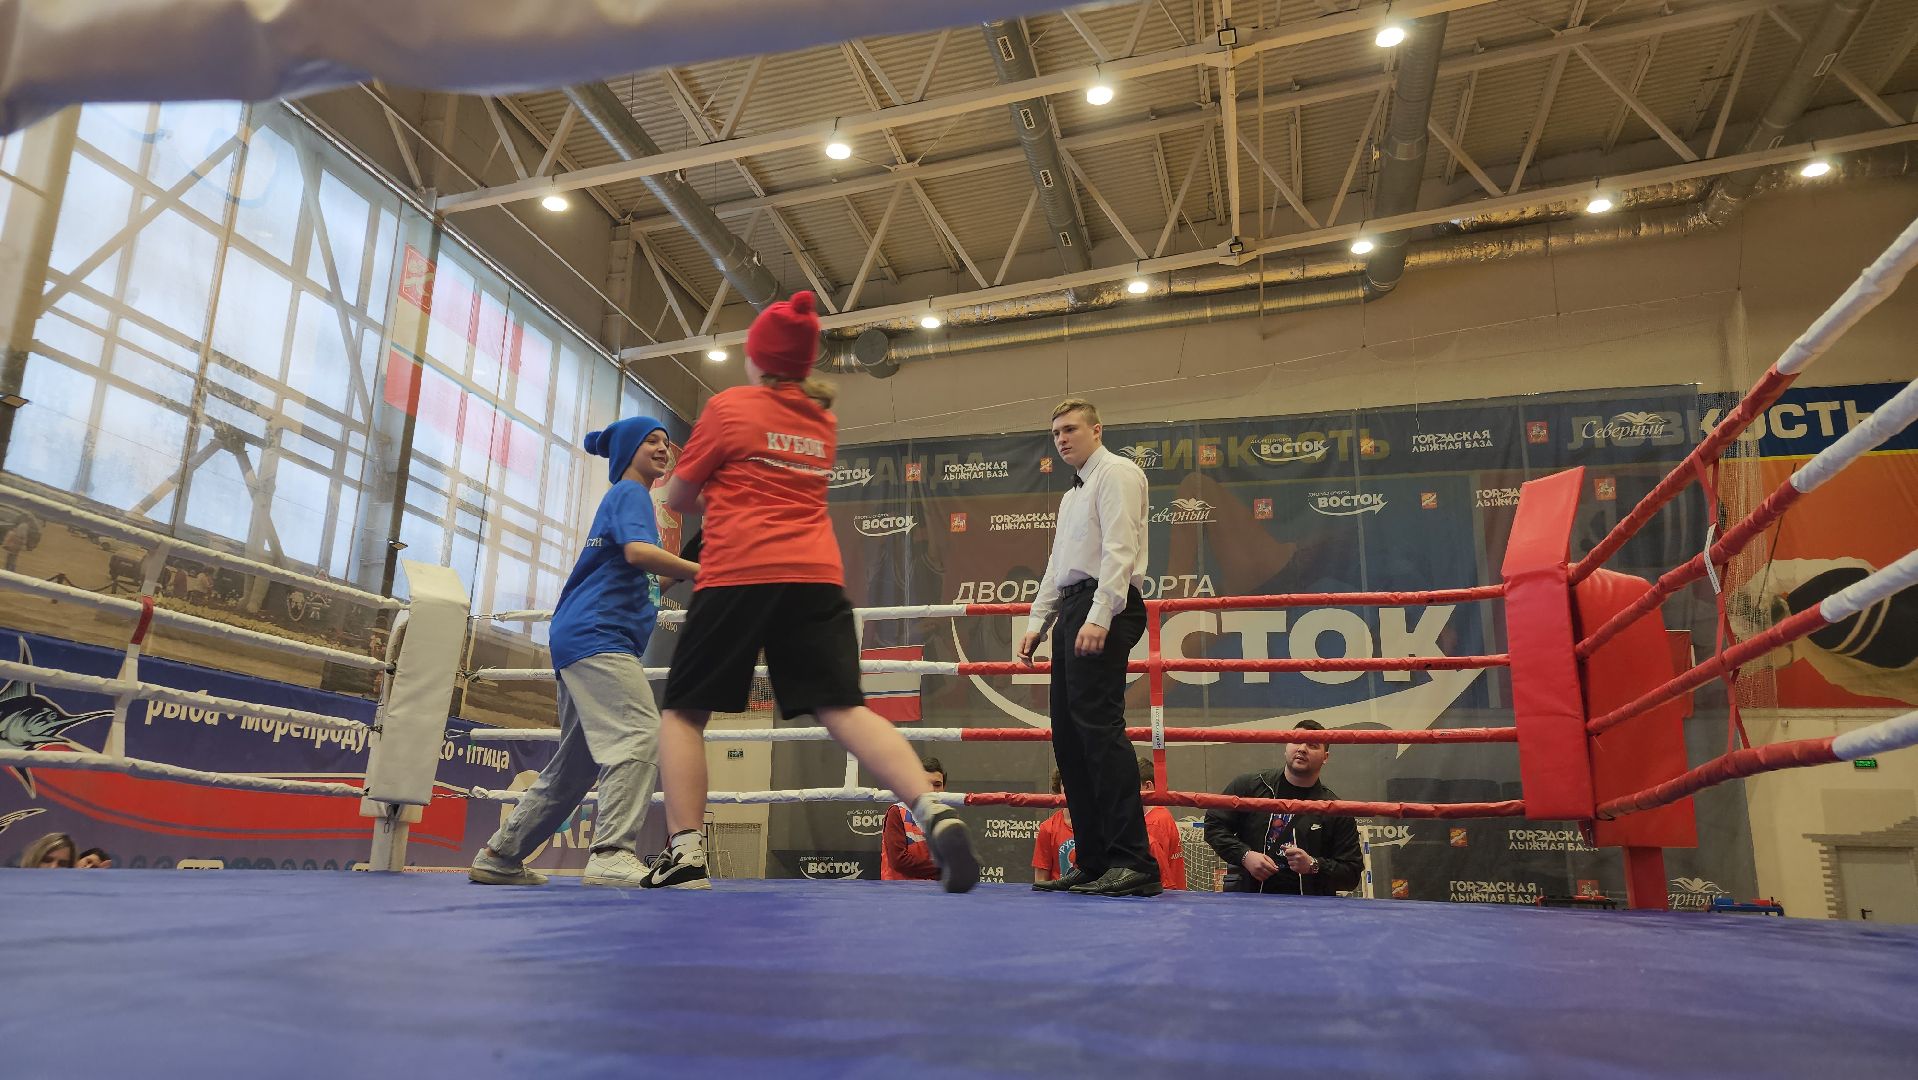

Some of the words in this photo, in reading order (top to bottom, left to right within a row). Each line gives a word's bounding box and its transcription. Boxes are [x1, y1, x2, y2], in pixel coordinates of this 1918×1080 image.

[1581, 420, 1664, 440] Северный
[1260, 440, 1326, 455] ВОСТОК
[1411, 441, 1462, 453] ЛЫЖНАЯ
[1464, 439, 1494, 449] БАЗА
[824, 468, 871, 482] ОСТОК
[986, 469, 1009, 478] БАЗА
[1317, 493, 1384, 509] ВОСТОК
[862, 515, 914, 530] ВОСТОК
[1033, 521, 1057, 529] БАЗА
[953, 579, 1041, 604] ДВОР
[1141, 574, 1216, 599] ОРТА
[1012, 604, 1456, 685] ВСТОК
[465, 743, 510, 772] птица
[852, 814, 886, 827] ВОСТ
[984, 829, 1031, 839] ЛЫЖНАЯ
[1508, 840, 1565, 851] ЛЫЖНАЯ
[807, 861, 860, 874] ВОСТОК
[1449, 892, 1506, 902] ЛЫЖНАЯ
